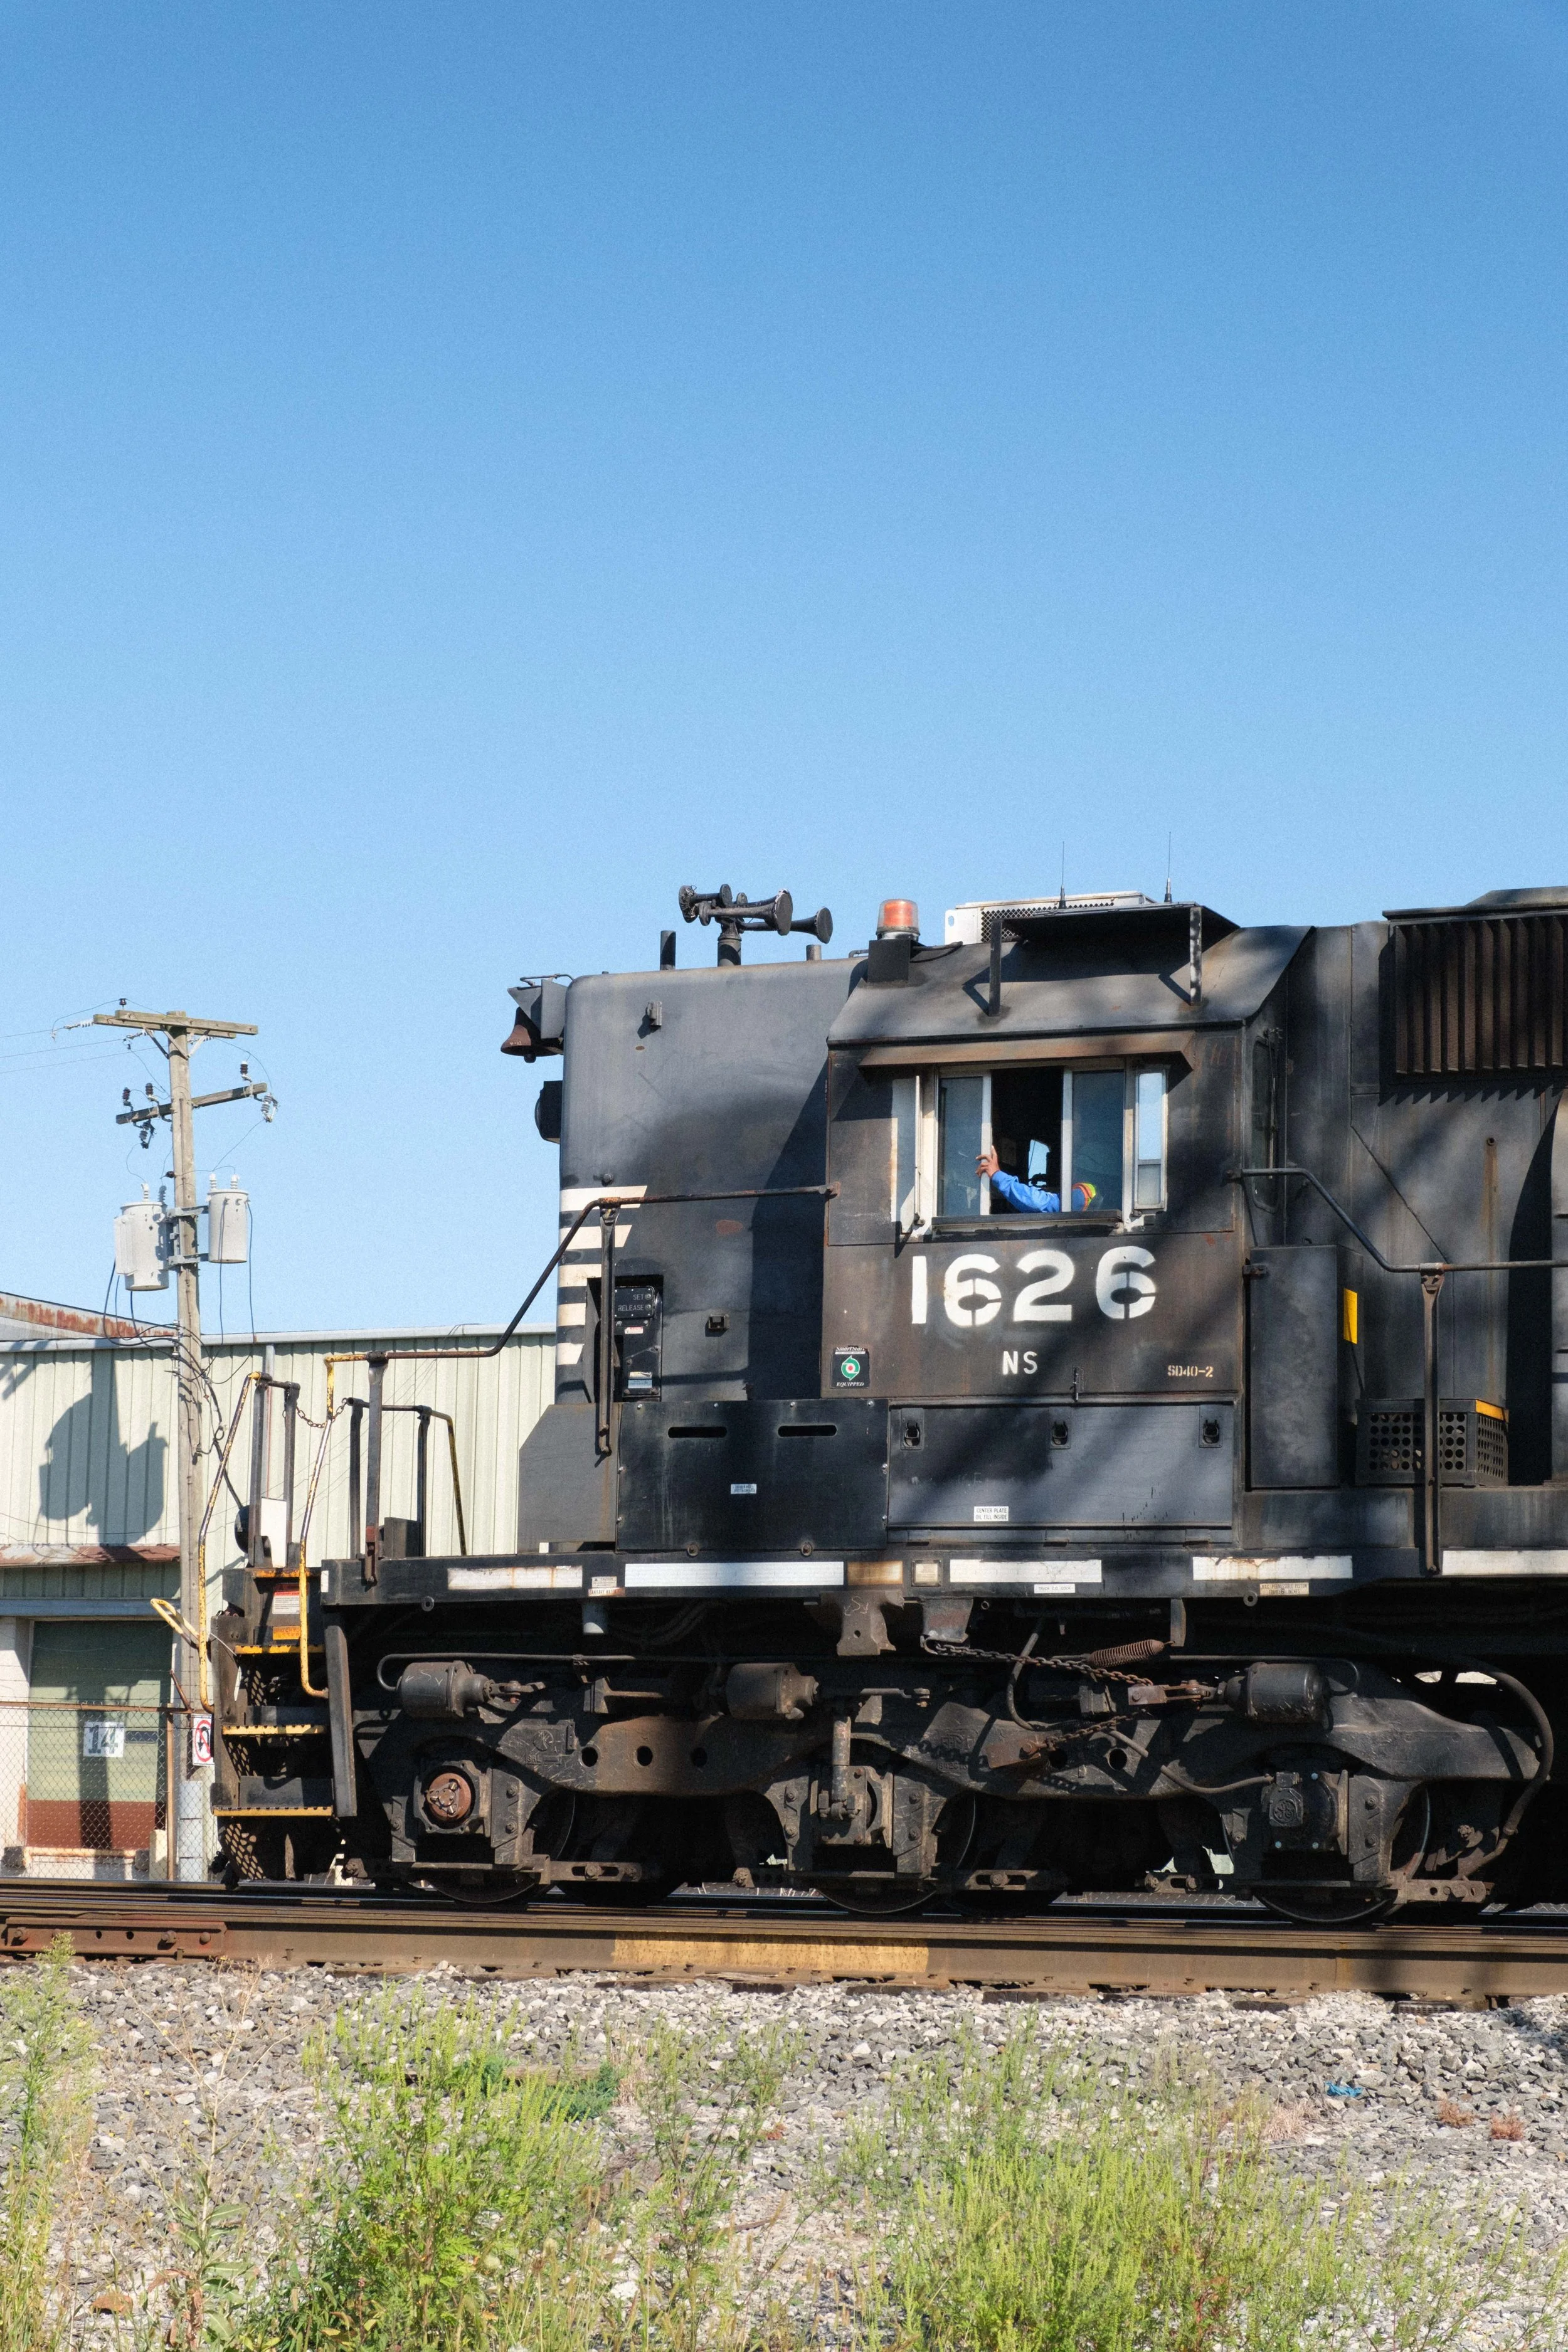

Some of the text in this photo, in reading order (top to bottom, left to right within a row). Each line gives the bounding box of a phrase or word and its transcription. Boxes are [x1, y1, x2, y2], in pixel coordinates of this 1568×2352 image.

[911, 1246, 1157, 1327] 1626
[1002, 1350, 1038, 1375] NS
[1167, 1365, 1214, 1377] SD40-2
[88, 1725, 119, 1754] 14
